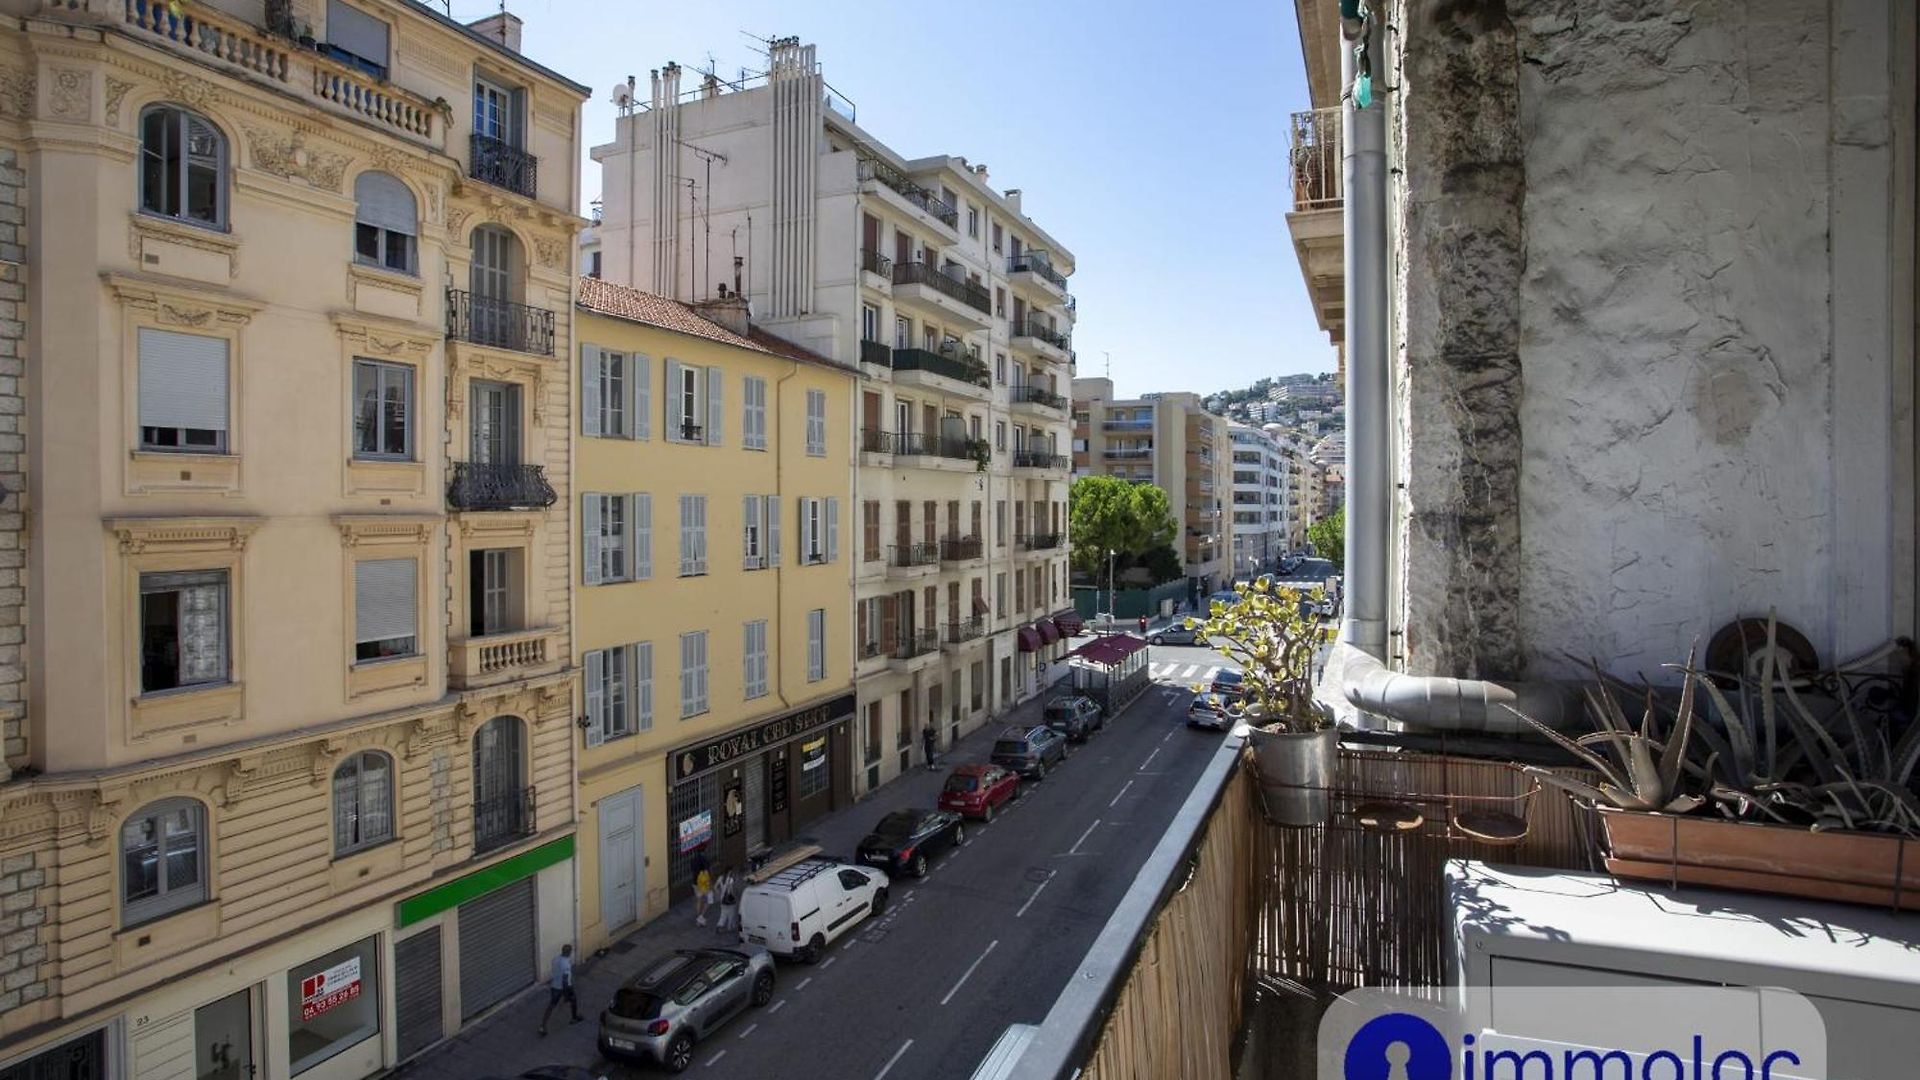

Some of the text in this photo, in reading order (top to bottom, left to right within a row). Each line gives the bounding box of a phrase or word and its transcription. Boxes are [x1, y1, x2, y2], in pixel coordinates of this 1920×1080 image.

[708, 731, 761, 765] ROYAL
[763, 719, 792, 744] CBD
[795, 705, 831, 731] SHOP
